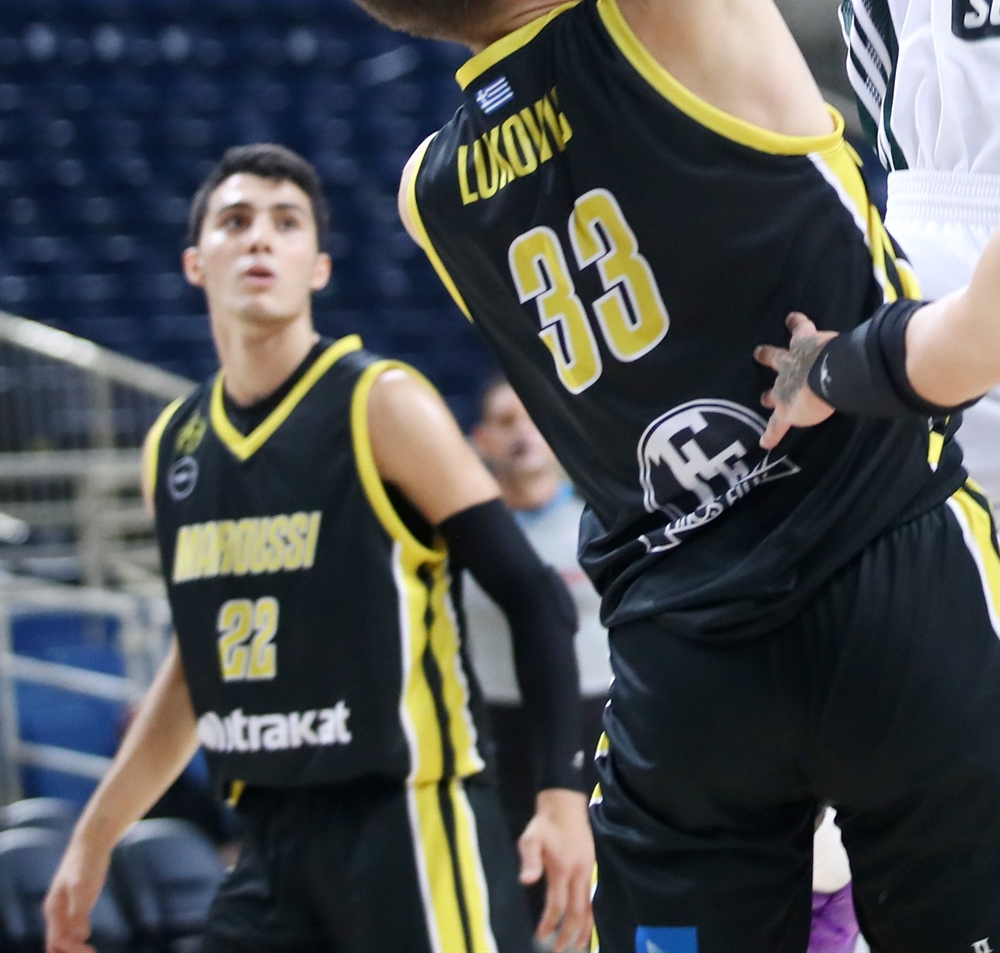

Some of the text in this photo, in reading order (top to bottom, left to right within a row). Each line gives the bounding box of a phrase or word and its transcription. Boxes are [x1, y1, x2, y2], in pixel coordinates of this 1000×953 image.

[508, 188, 670, 395] 33
[173, 510, 322, 584] MAROUSSI
[217, 597, 278, 683] 22
